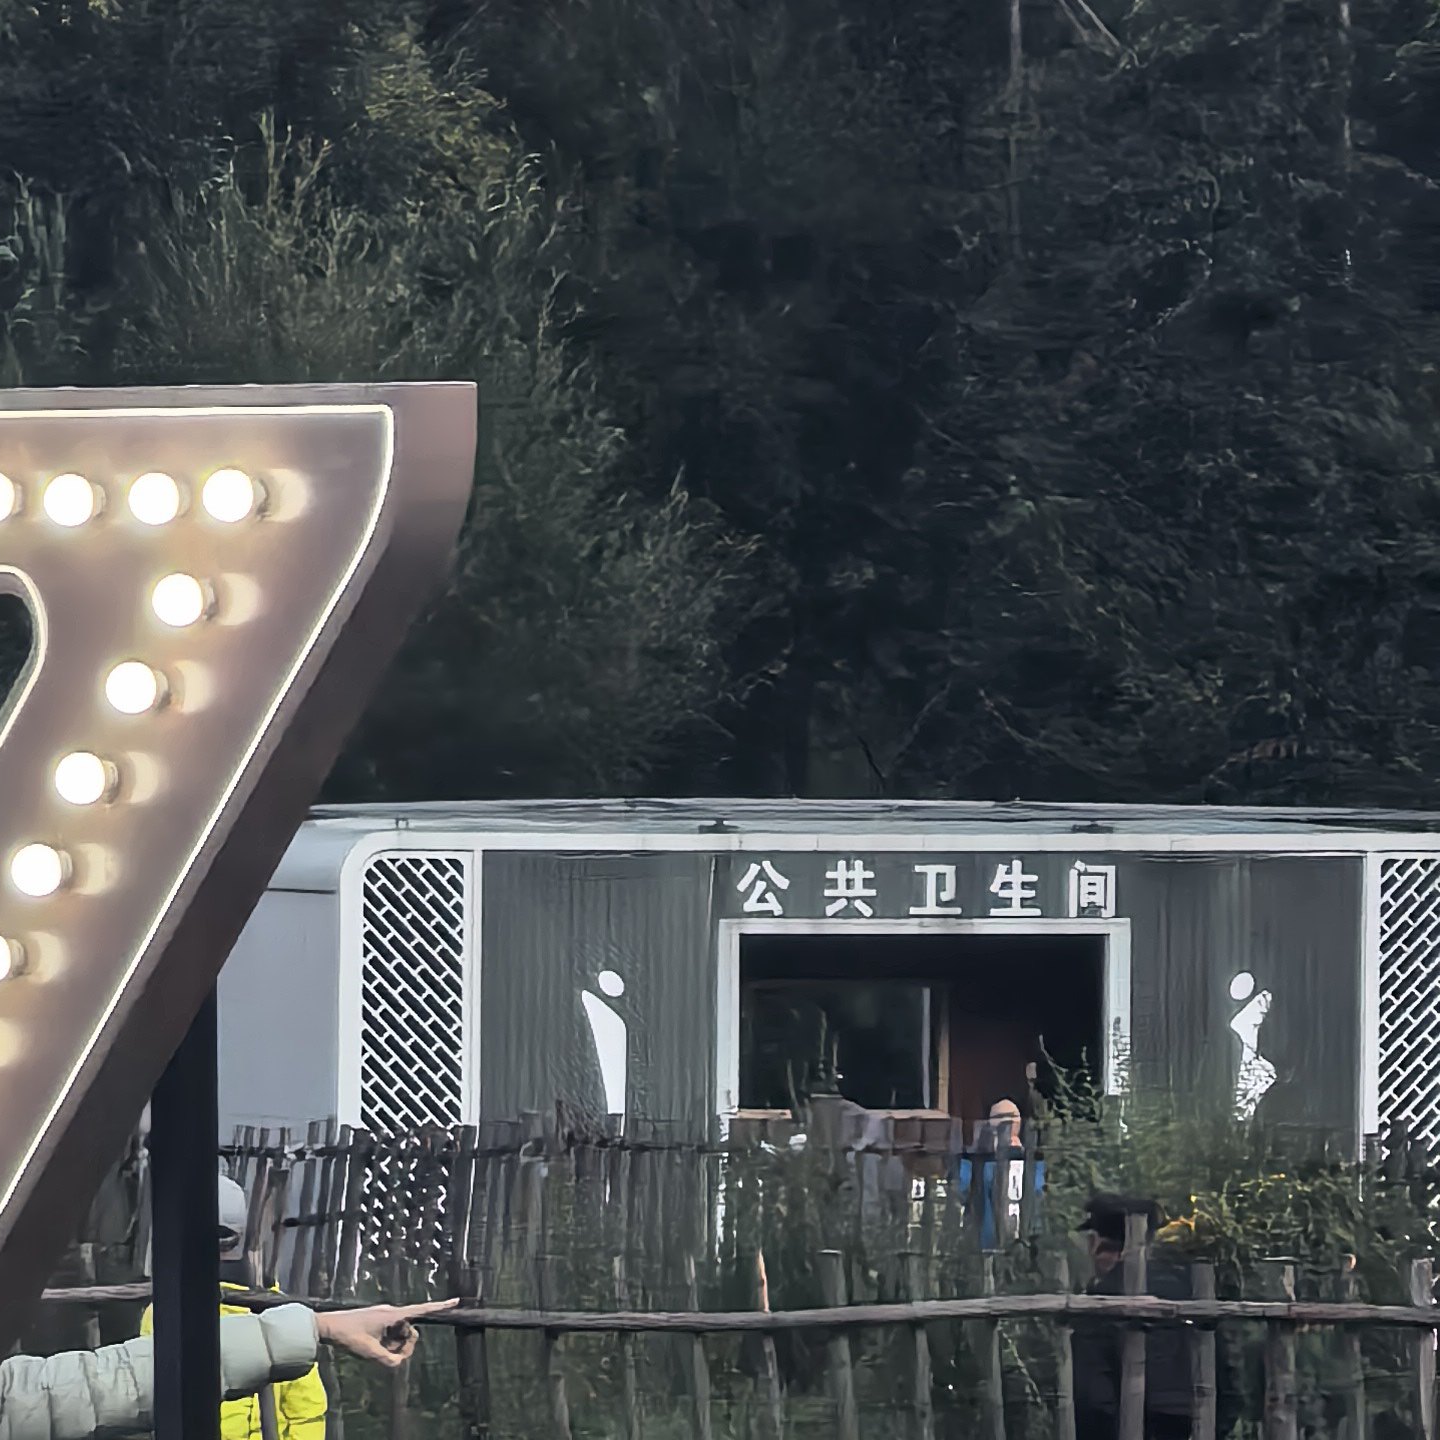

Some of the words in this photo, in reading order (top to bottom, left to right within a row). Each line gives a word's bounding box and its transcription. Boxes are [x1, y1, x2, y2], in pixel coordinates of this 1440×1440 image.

[736, 859, 1117, 918] 公共卫生间
